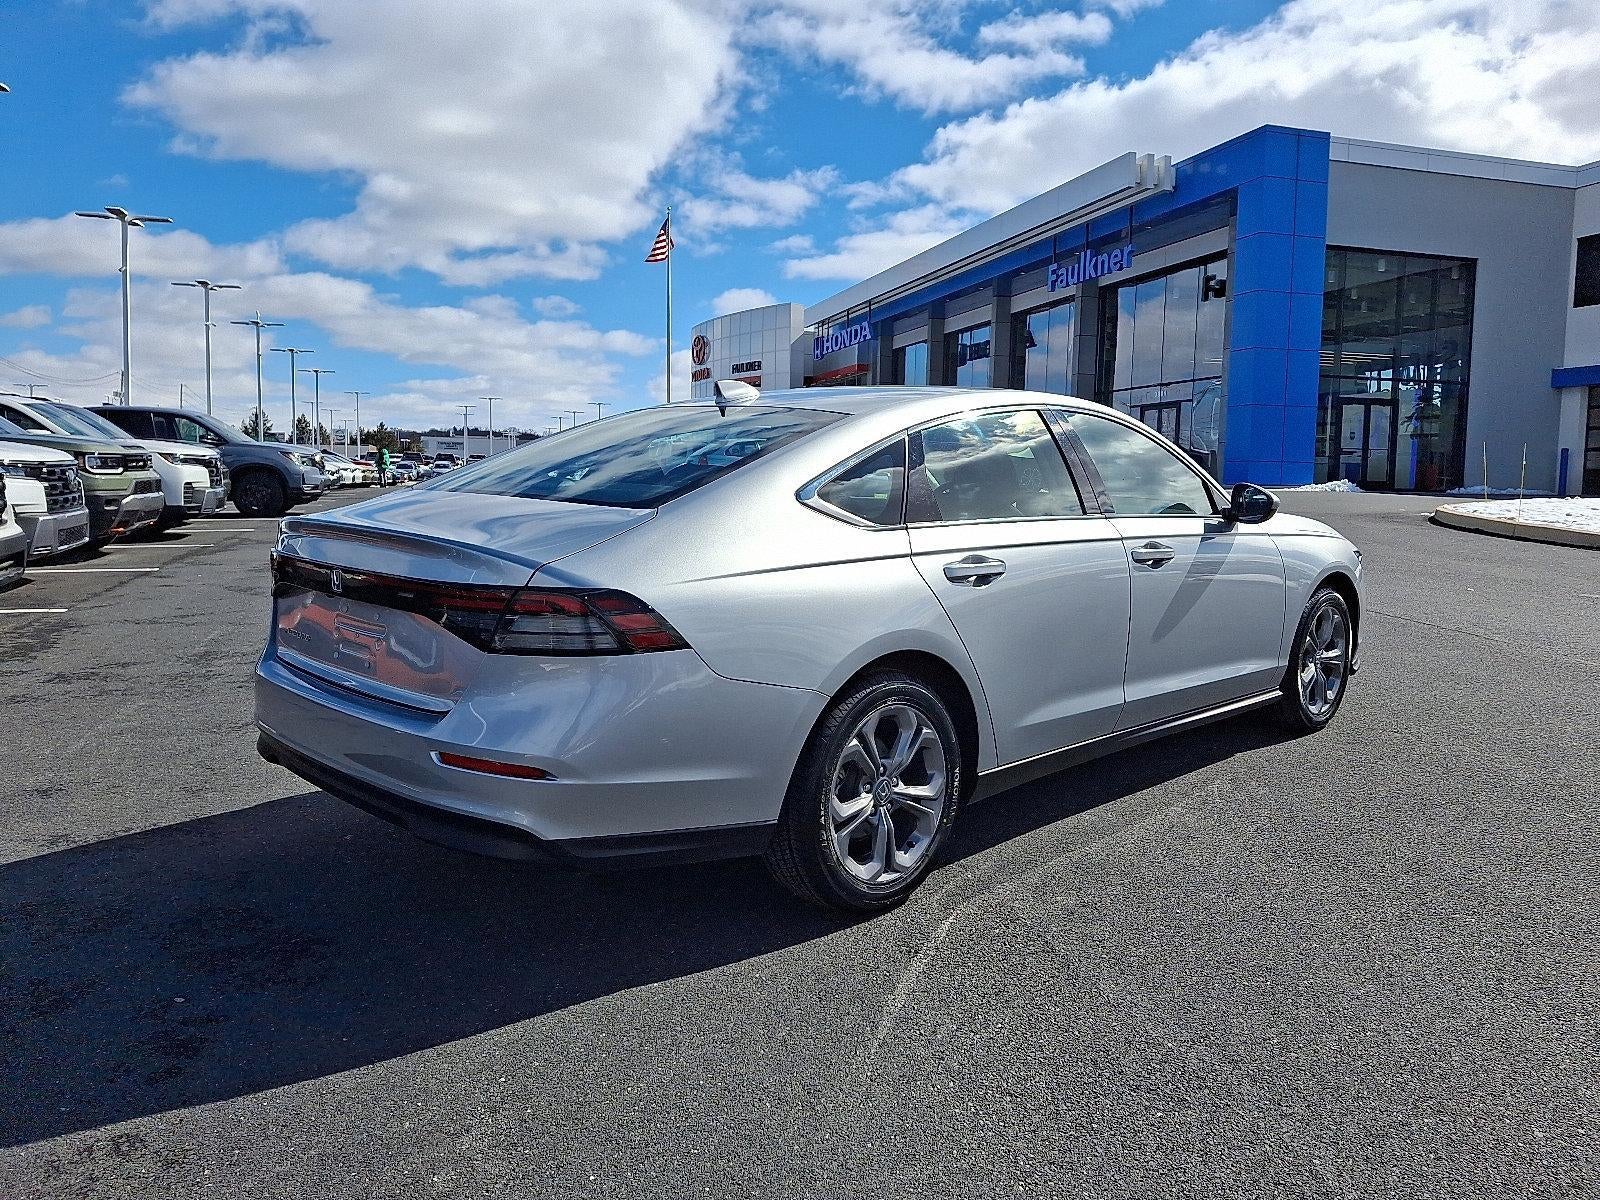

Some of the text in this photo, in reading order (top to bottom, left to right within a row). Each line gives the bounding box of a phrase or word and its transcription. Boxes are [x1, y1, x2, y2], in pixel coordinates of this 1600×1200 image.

[1047, 243, 1134, 292] Faulkner
[822, 320, 872, 355] HONDA
[731, 360, 762, 375] FAULKNER
